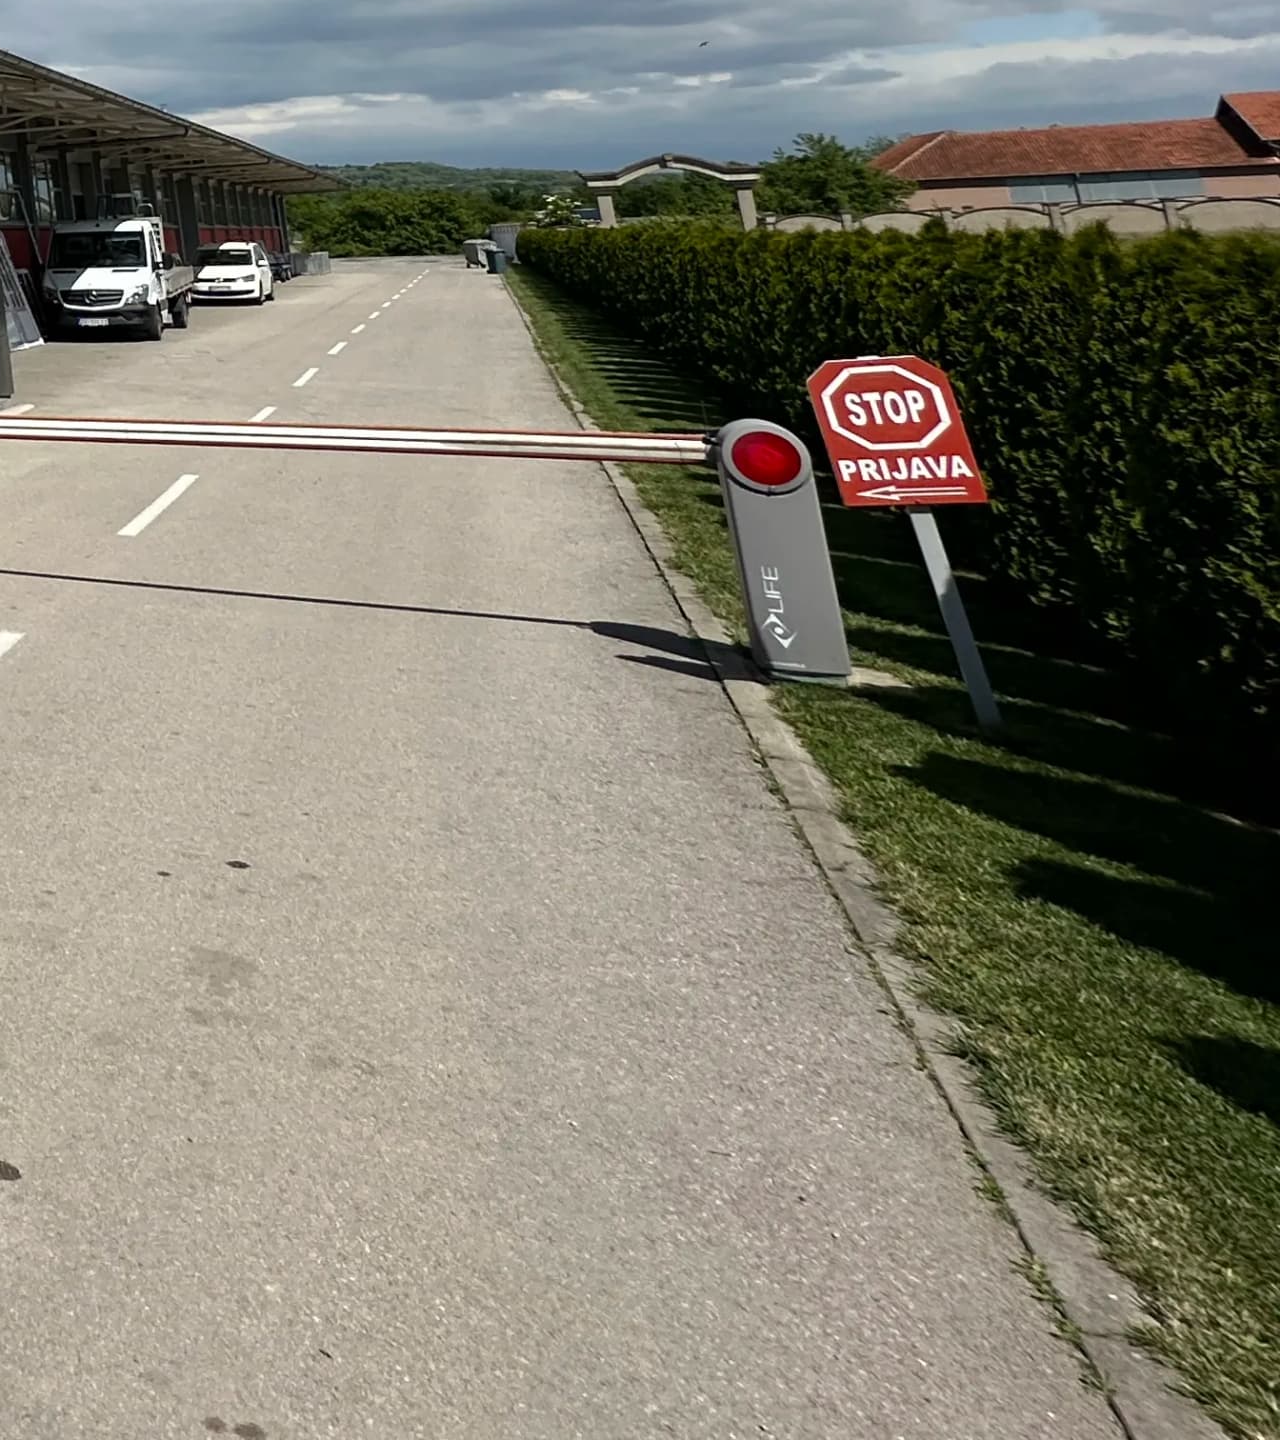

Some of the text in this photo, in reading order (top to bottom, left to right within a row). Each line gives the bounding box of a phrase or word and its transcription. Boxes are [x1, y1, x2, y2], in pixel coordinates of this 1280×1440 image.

[844, 390, 926, 426] STOP
[838, 455, 973, 482] PRIJAVA
[761, 566, 784, 613] LIFE
